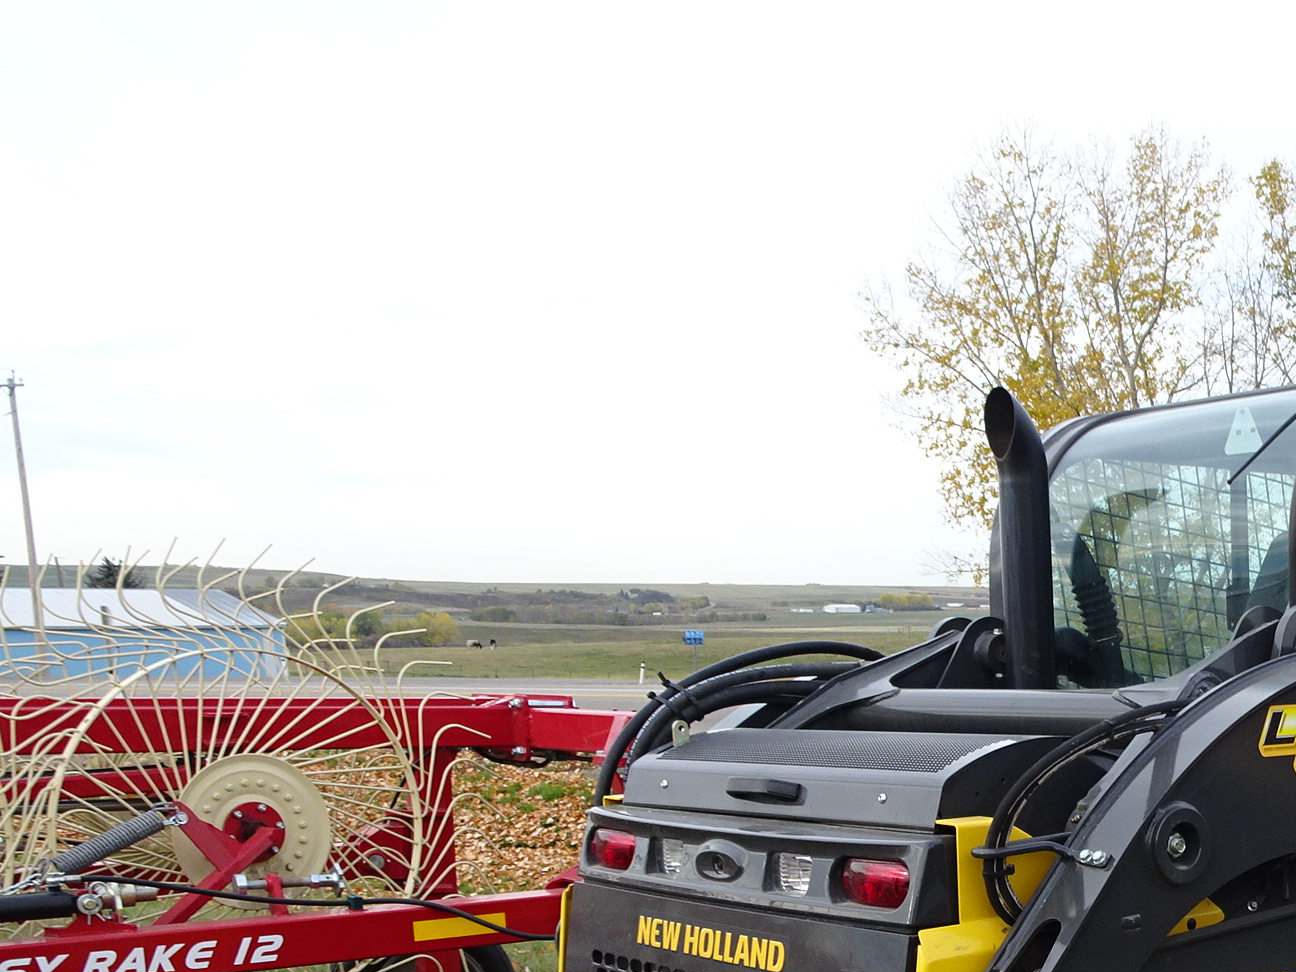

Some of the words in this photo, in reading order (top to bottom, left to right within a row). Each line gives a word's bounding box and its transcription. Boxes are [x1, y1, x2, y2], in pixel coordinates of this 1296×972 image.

[233, 934, 284, 966] 12
[636, 915, 682, 951] NEW
[683, 924, 785, 972] HOLLAND
